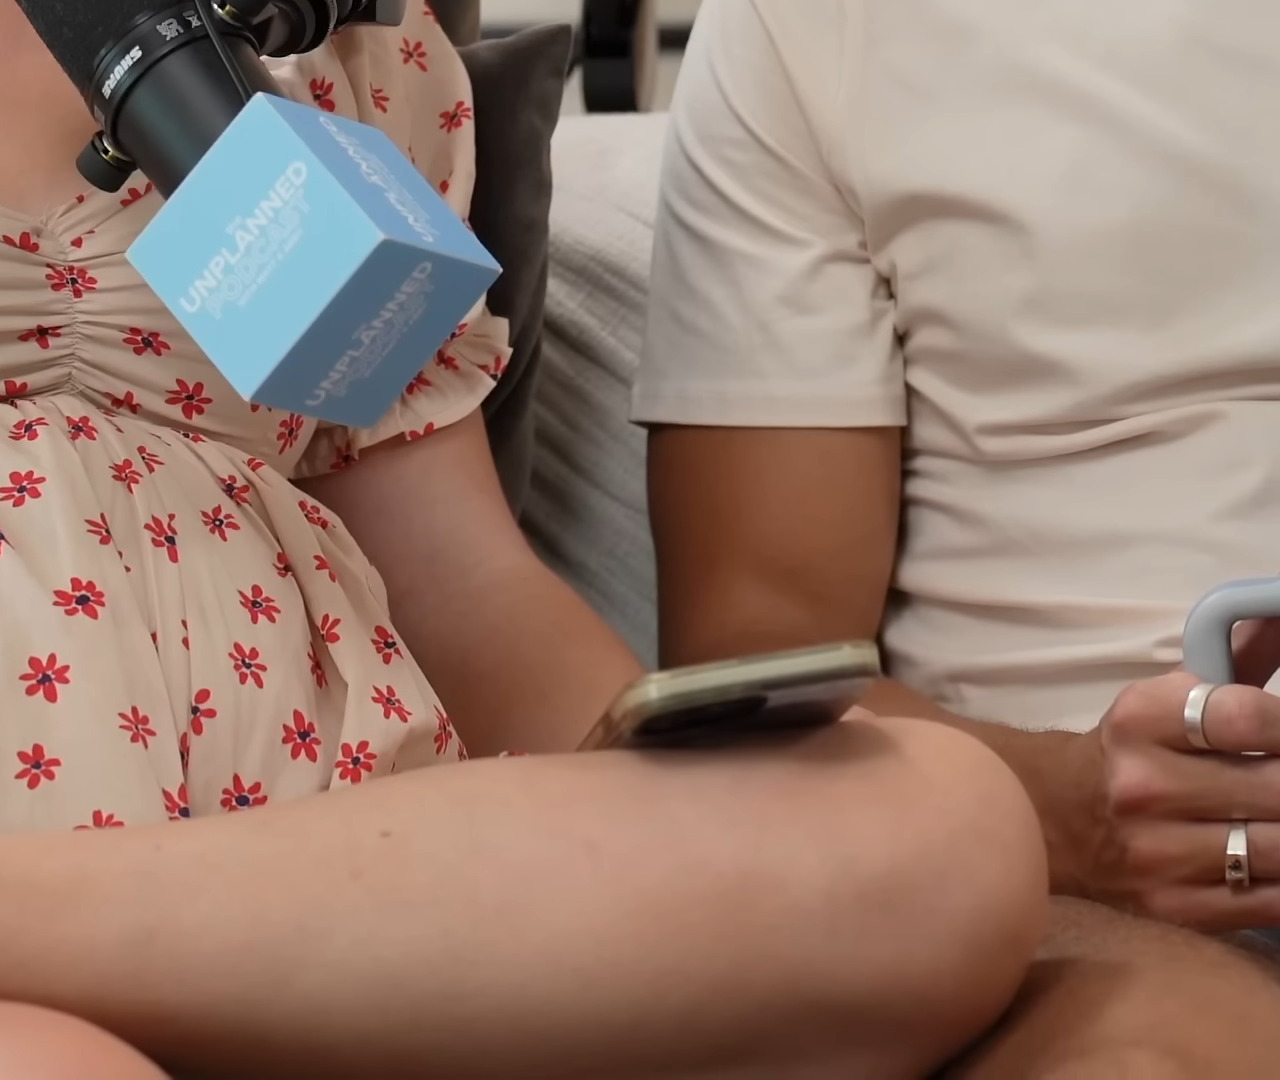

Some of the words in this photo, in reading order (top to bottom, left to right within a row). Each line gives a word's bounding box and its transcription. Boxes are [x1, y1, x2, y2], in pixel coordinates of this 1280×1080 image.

[102, 45, 142, 99] SHURE
[179, 161, 307, 313] UNPLANNED
[304, 261, 432, 406] UNPLANNED
